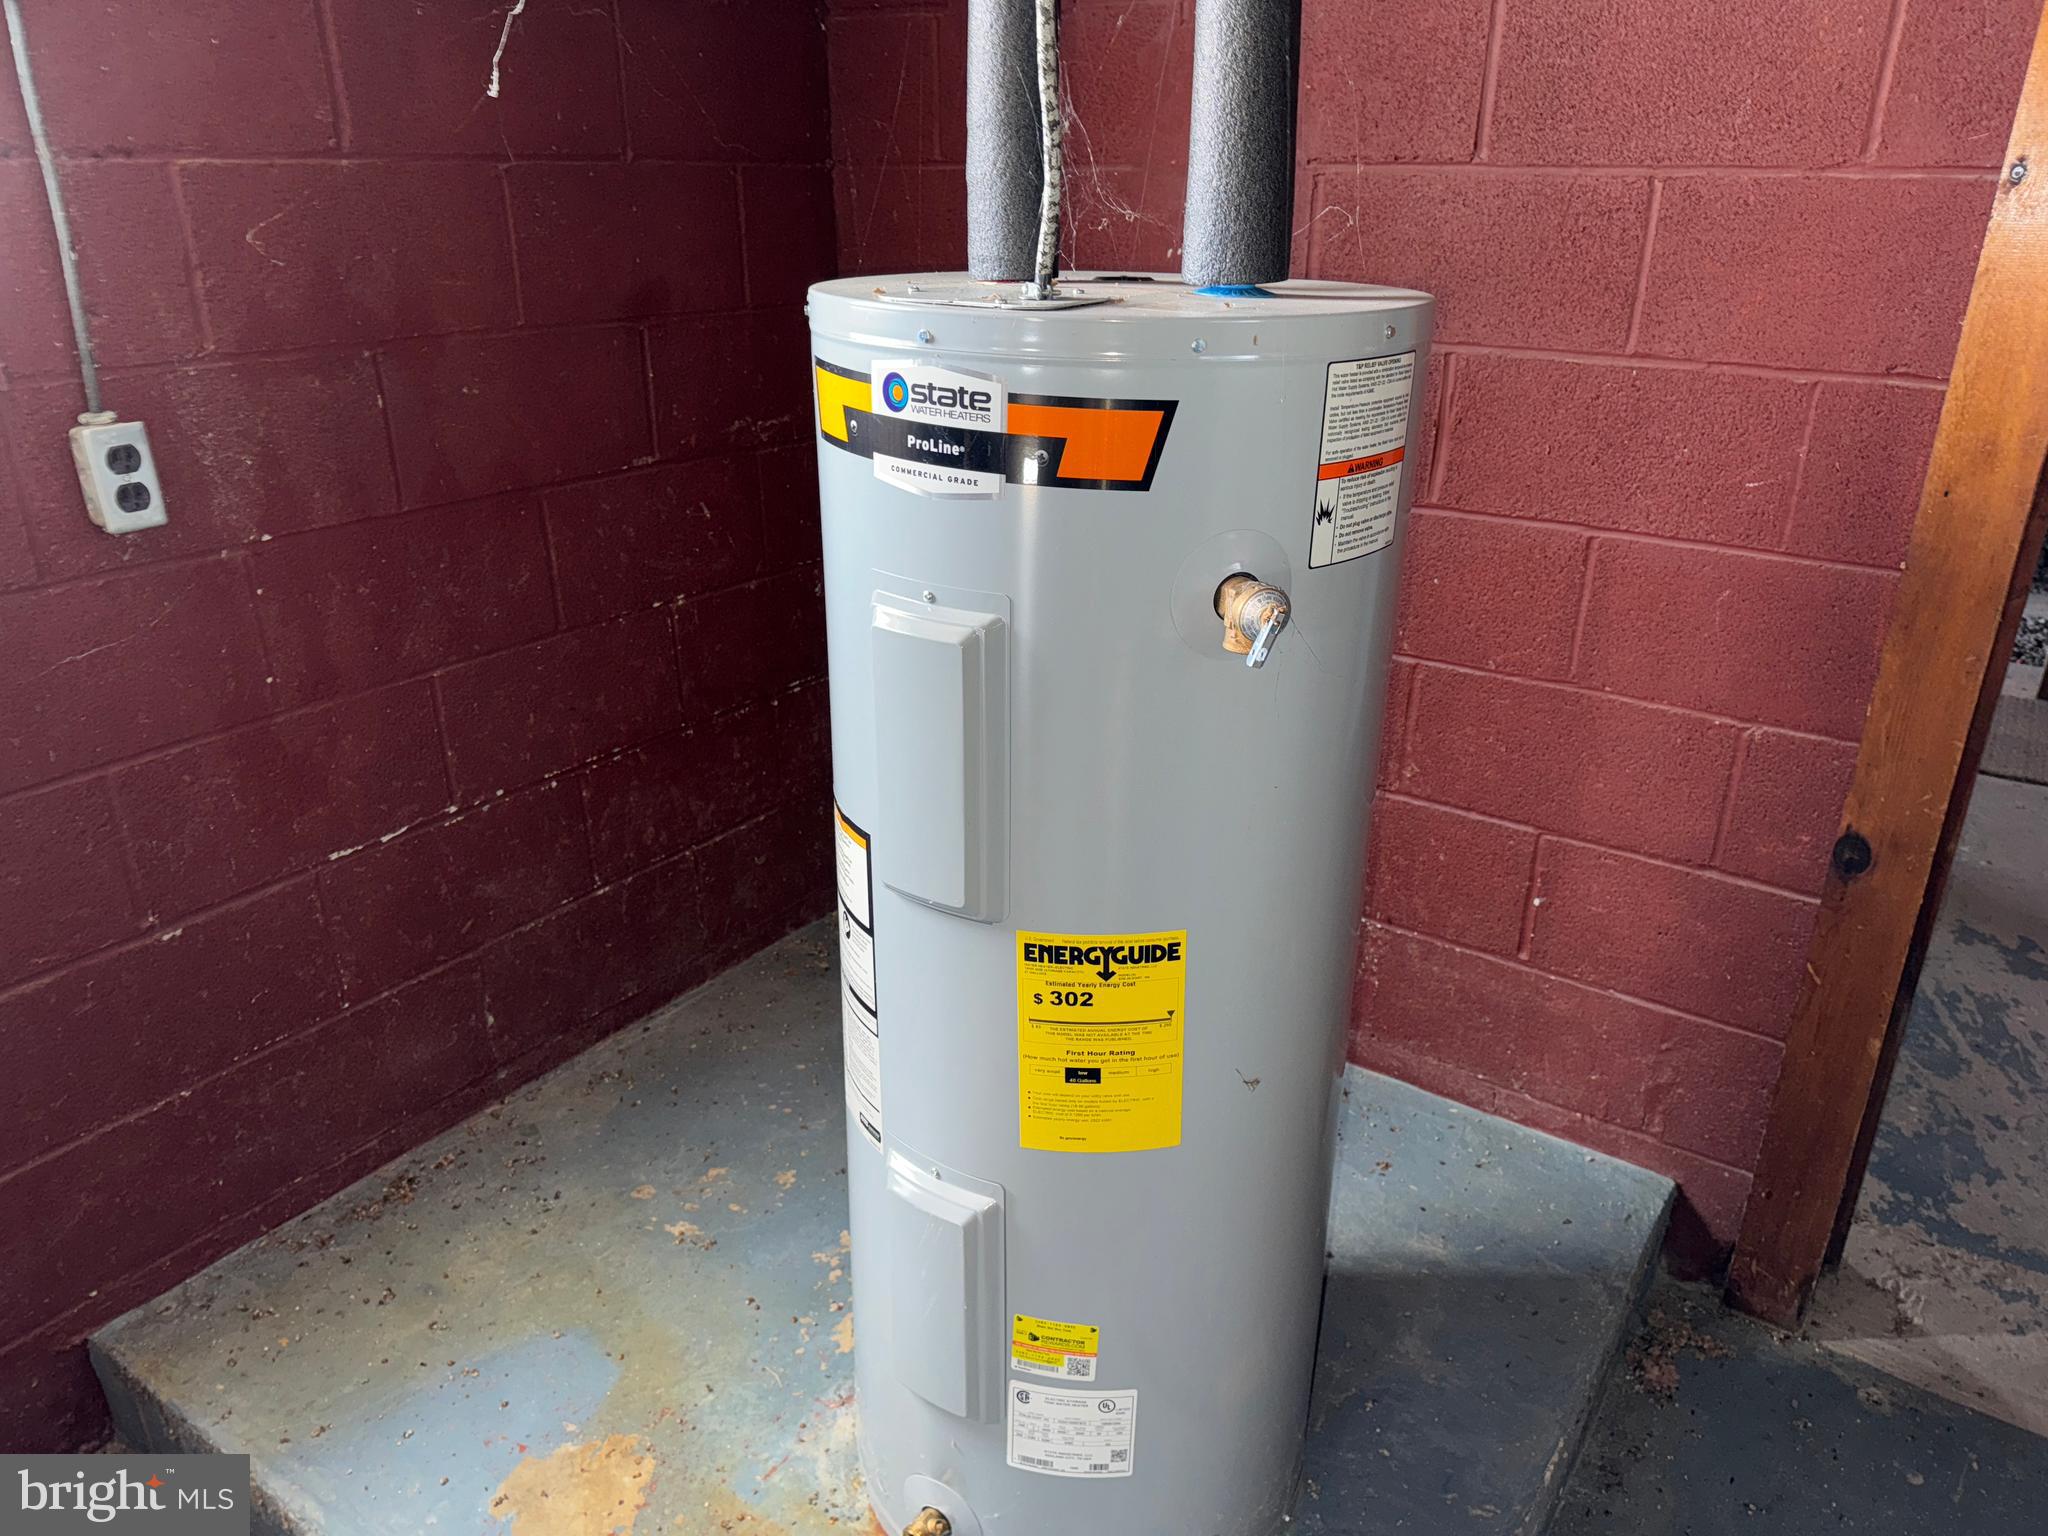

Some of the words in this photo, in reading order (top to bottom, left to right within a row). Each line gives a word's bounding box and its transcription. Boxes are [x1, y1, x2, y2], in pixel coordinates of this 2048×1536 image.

[911, 383, 991, 412] state
[911, 405, 942, 417] WATER
[943, 408, 991, 424] HEATERS
[1354, 457, 1384, 472] WARNING
[891, 465, 943, 482] COMMERCIAL
[947, 475, 979, 487] GRADE
[1024, 942, 1181, 967] ENERGYGUIDE
[1033, 992, 1043, 1005] $
[1050, 990, 1094, 1007] 302
[1041, 1334, 1086, 1345] CONTRACTOR
